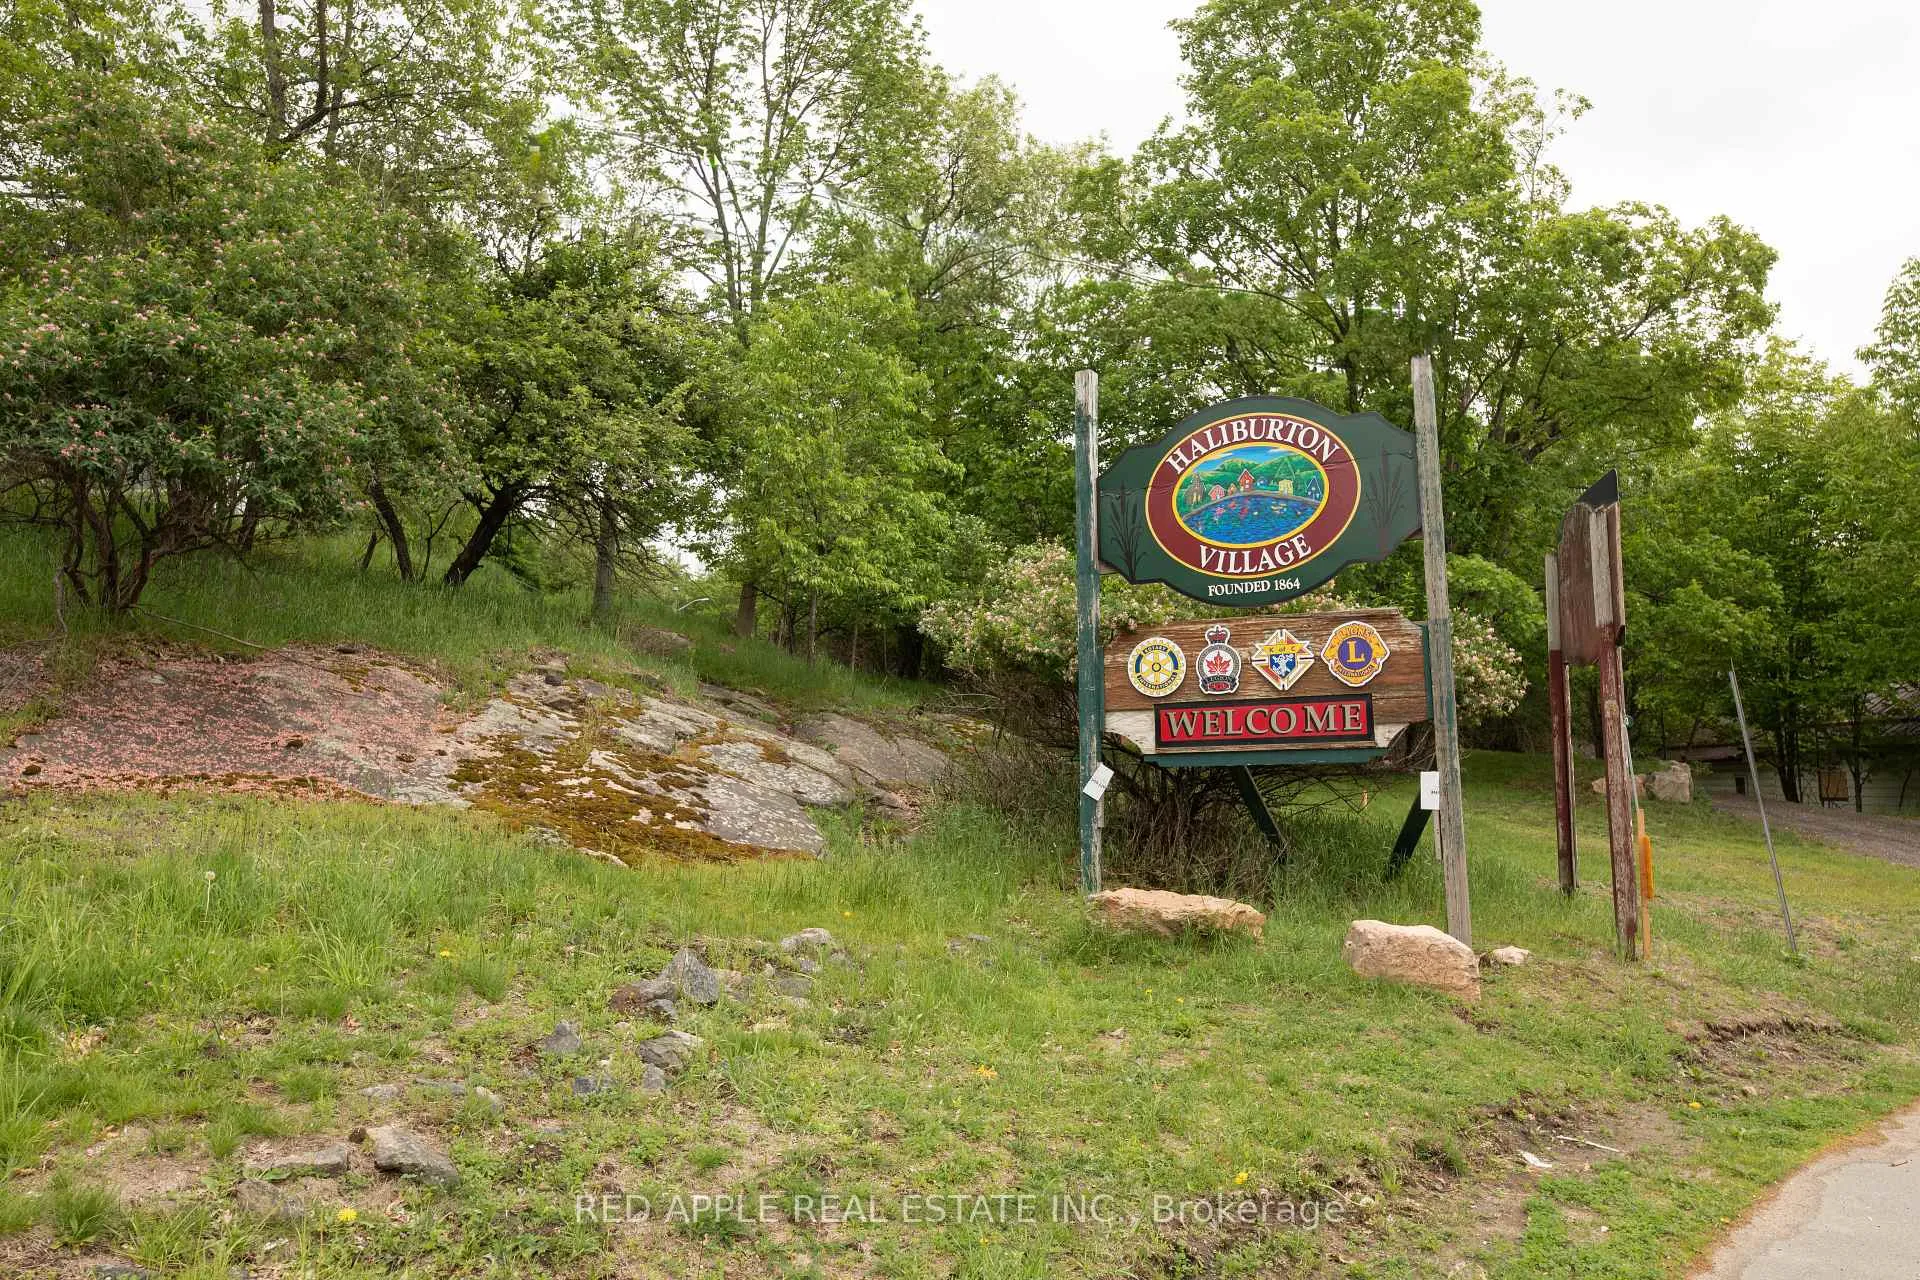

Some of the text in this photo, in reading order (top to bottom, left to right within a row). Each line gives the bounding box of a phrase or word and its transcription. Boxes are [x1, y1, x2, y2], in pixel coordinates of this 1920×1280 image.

[1165, 418, 1341, 474] HALIBURTON
[1199, 533, 1312, 573] VILLAGE
[1208, 577, 1300, 596] FOUNDED 1864
[1347, 640, 1365, 663] L
[1165, 703, 1363, 738] WELCOME
